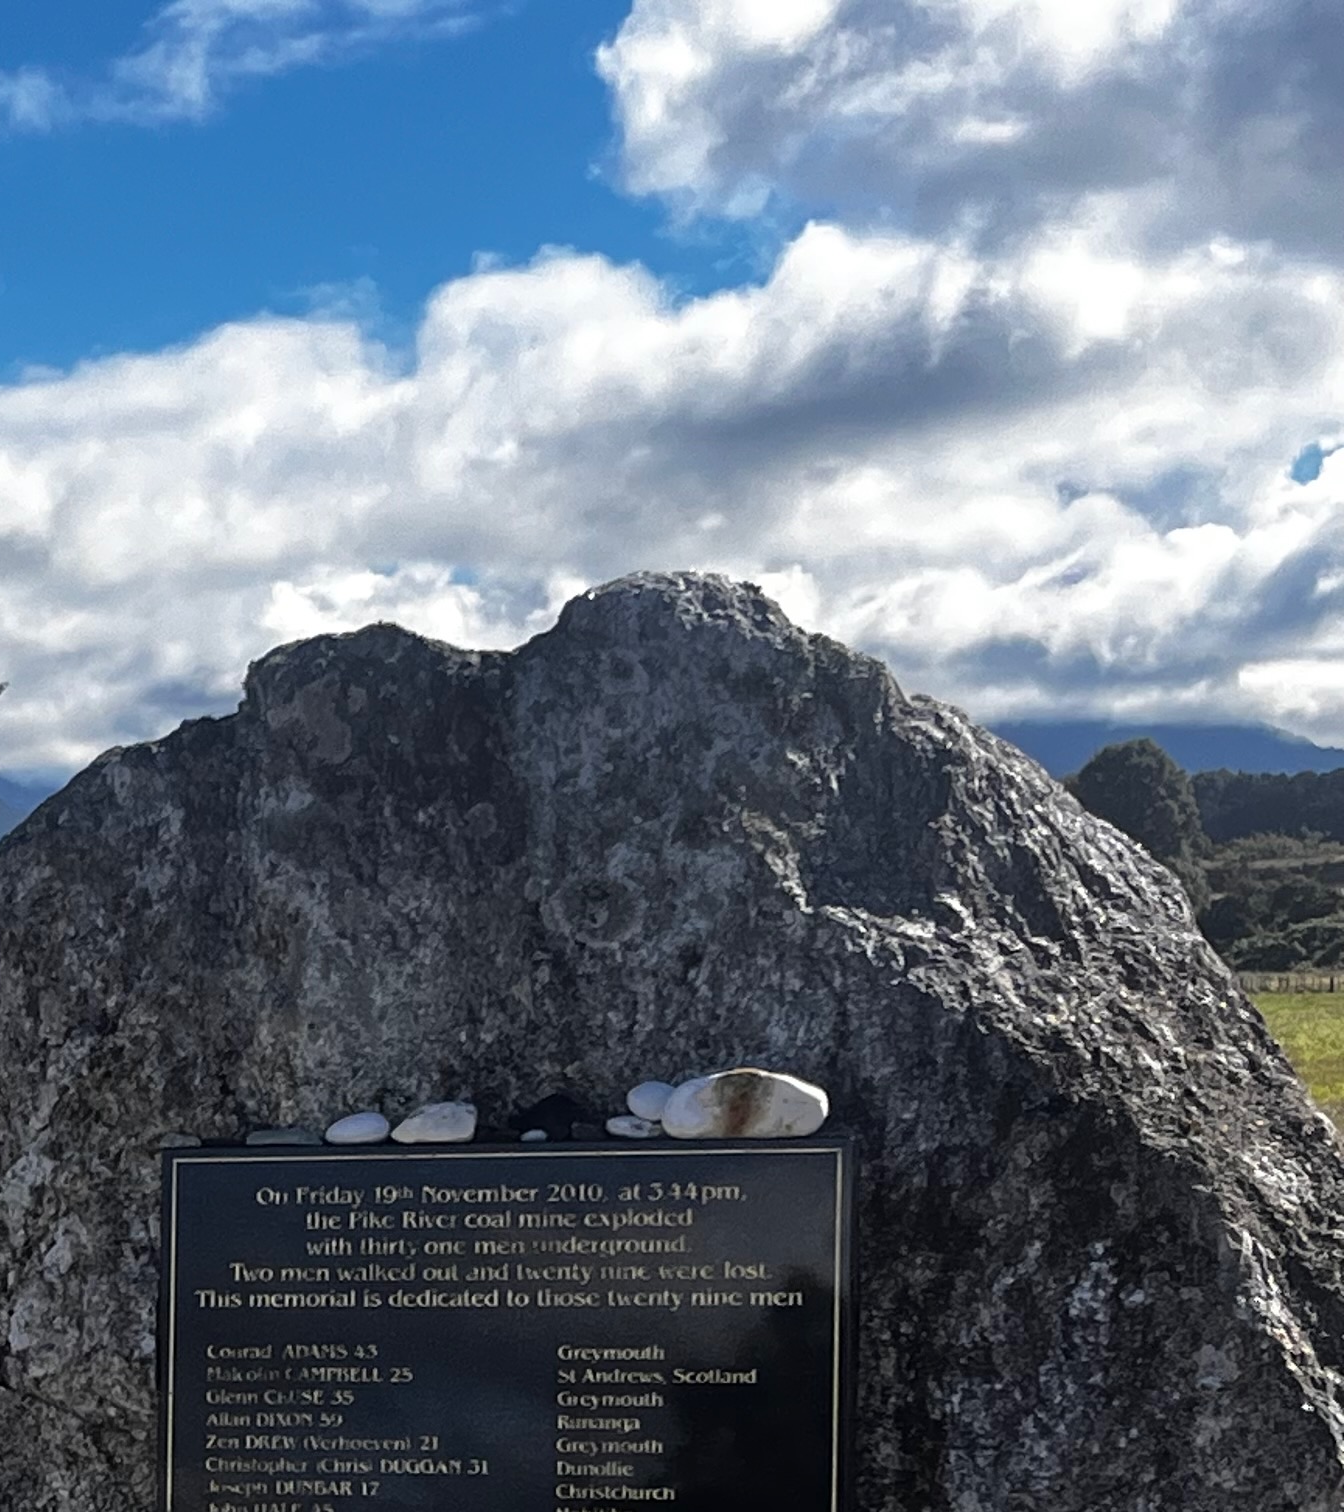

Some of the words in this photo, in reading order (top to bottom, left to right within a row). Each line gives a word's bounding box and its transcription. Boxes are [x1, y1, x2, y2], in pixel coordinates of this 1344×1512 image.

[256, 1187, 288, 1205] On
[296, 1186, 364, 1208] Friday
[375, 1185, 414, 1203] 19th
[422, 1185, 537, 1203] November
[618, 1184, 640, 1200] at
[306, 1212, 341, 1229] the
[349, 1212, 394, 1229] Pike
[402, 1211, 455, 1228] River
[465, 1211, 510, 1228] coal
[519, 1208, 576, 1228] mine
[584, 1208, 693, 1231] exploded
[307, 1238, 352, 1256] with
[360, 1238, 417, 1259] thirty
[424, 1240, 465, 1255] one
[475, 1239, 525, 1255] men
[230, 1263, 273, 1282] Two
[280, 1266, 329, 1281] men
[337, 1263, 415, 1281] walked
[423, 1264, 457, 1280] out
[465, 1263, 508, 1280] and
[517, 1263, 592, 1284] twenty
[600, 1263, 651, 1280] nine
[659, 1264, 714, 1280] were
[195, 1290, 242, 1308] This
[249, 1289, 355, 1308] memorial
[364, 1289, 381, 1307] is
[389, 1288, 499, 1307] dedicated
[507, 1289, 529, 1307] to
[537, 1289, 600, 1308] those
[608, 1289, 682, 1311] twenty
[691, 1287, 742, 1307] nine
[750, 1290, 803, 1306] men
[557, 1345, 665, 1362] Greymouth
[557, 1369, 577, 1383] St
[673, 1369, 756, 1384] Scotland
[557, 1392, 663, 1410] Greymouth
[557, 1415, 640, 1432] Runanga
[556, 1438, 662, 1456] Greymouth
[380, 1460, 461, 1474] DUGGAN
[556, 1461, 633, 1476] Dunollie
[556, 1485, 675, 1500] Christchurch
